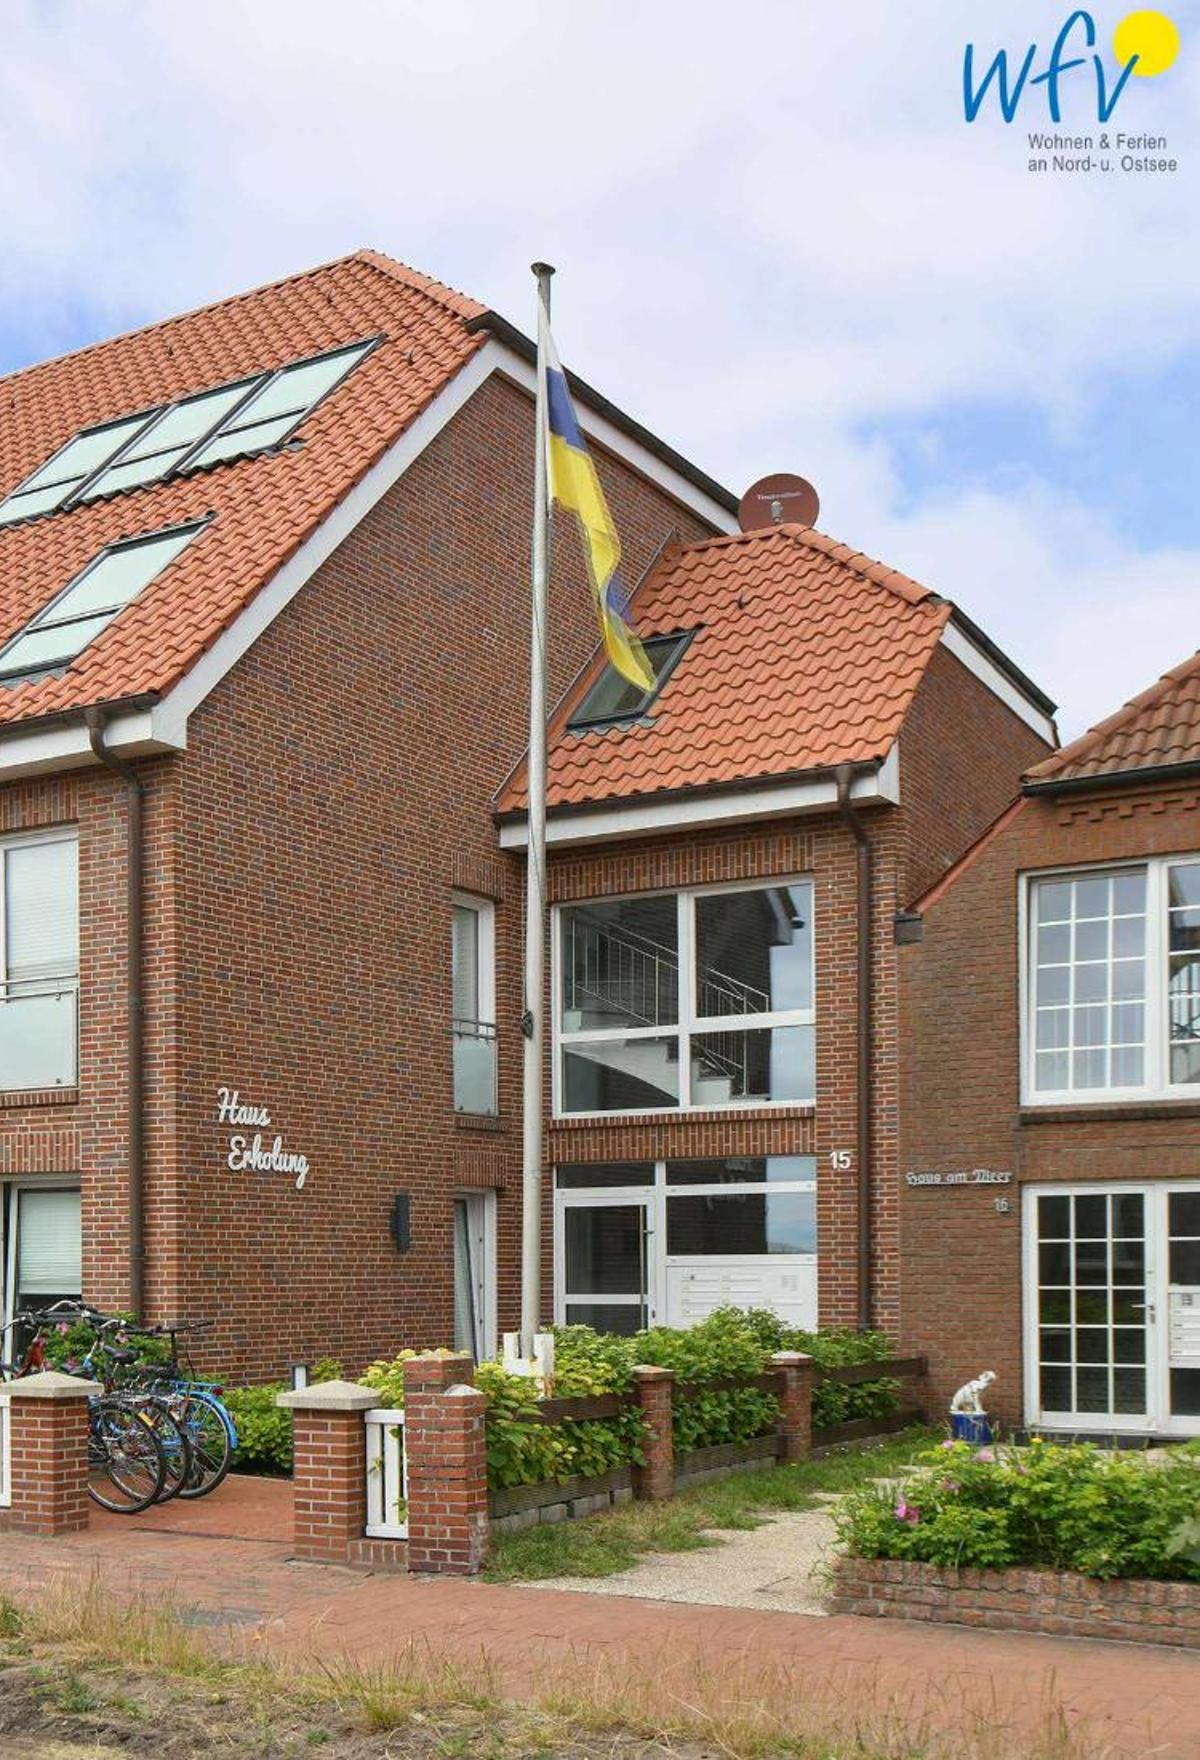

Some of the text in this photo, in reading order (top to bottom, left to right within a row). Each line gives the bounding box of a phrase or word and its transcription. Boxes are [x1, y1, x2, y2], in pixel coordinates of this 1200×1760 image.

[217, 1087, 271, 1126] Haus
[228, 1134, 309, 1189] Erholung
[830, 1151, 851, 1169] 15
